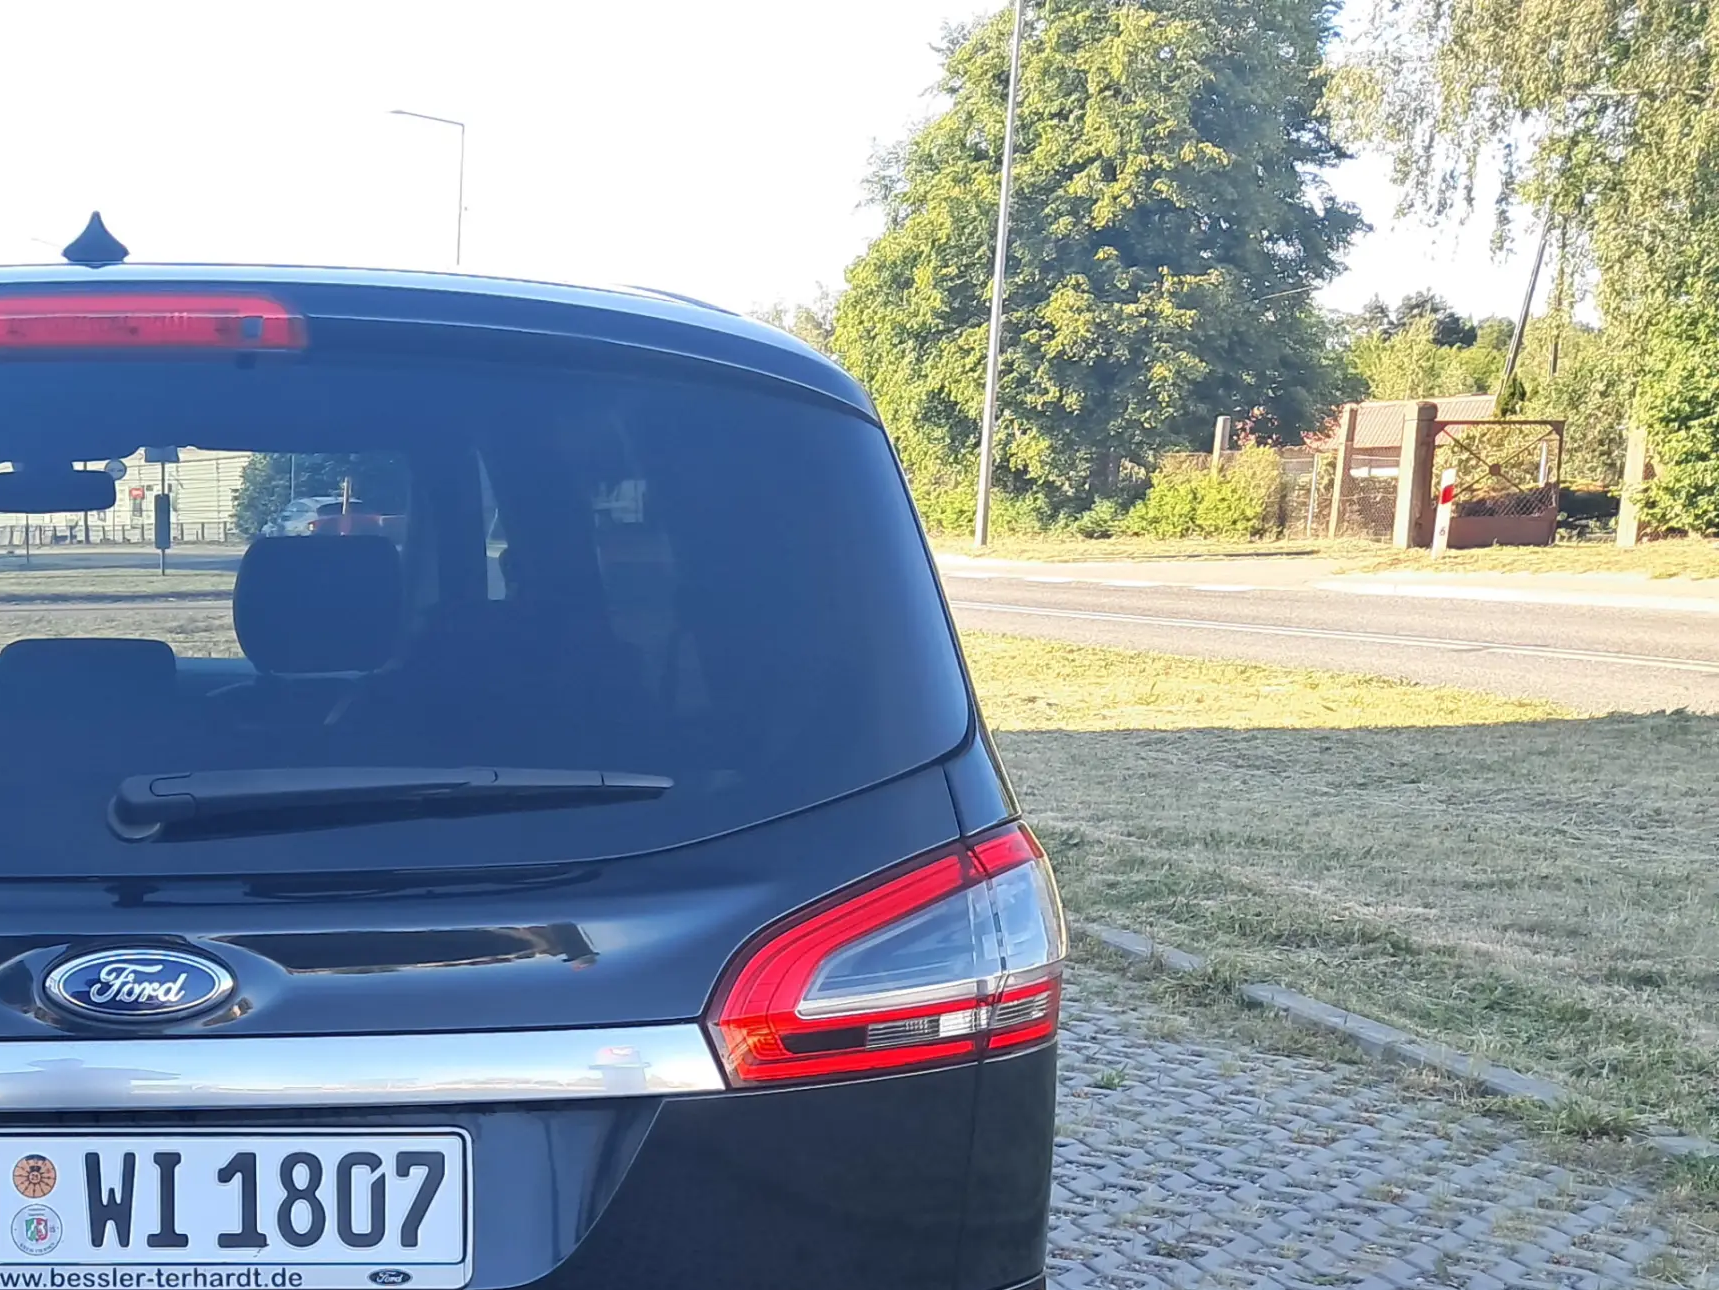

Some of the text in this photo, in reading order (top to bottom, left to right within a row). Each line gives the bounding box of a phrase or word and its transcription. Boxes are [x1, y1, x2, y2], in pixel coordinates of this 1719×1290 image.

[89, 963, 188, 1003] Ford
[84, 1152, 189, 1248] WI
[217, 1151, 446, 1248] 1807
[376, 1270, 403, 1283] Ford
